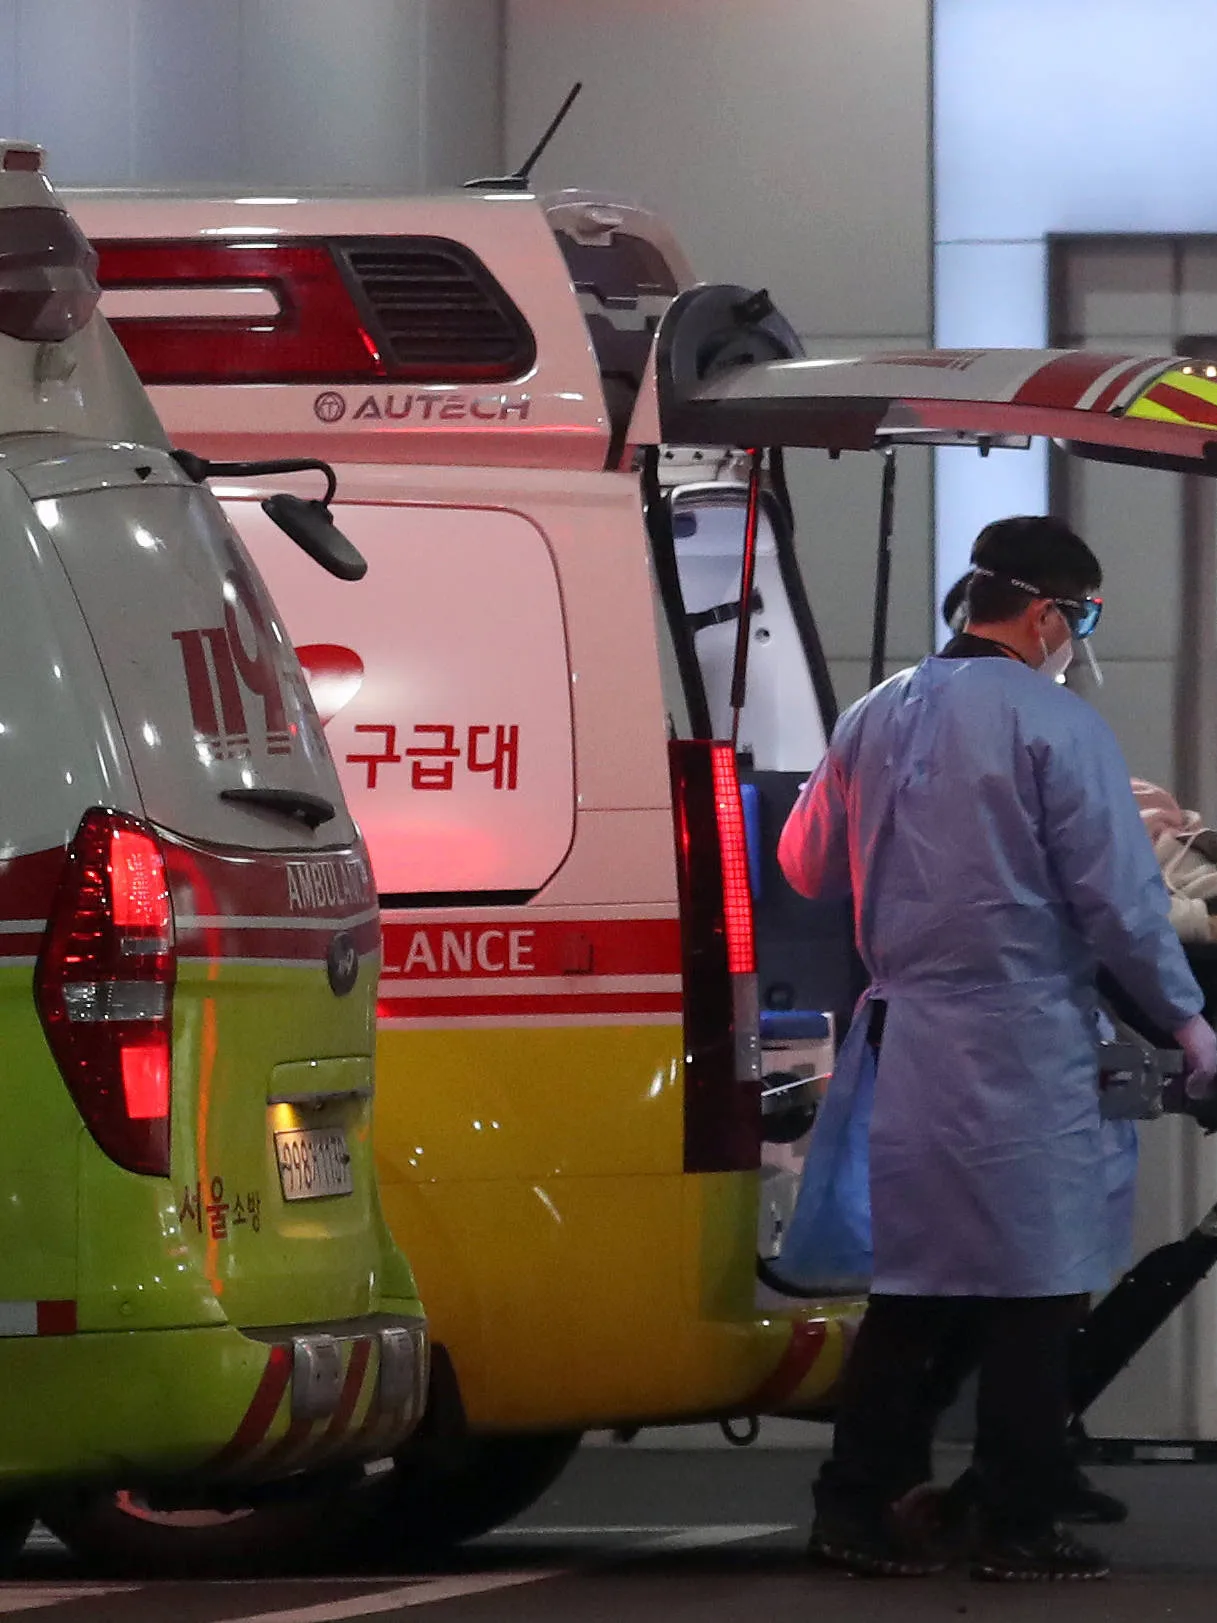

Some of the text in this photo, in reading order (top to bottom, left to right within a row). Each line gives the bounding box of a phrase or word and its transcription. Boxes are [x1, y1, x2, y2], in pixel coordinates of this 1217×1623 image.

[352, 393, 531, 421] AUTECH
[346, 723, 519, 791] 구급대
[179, 1175, 230, 1240] 서울
